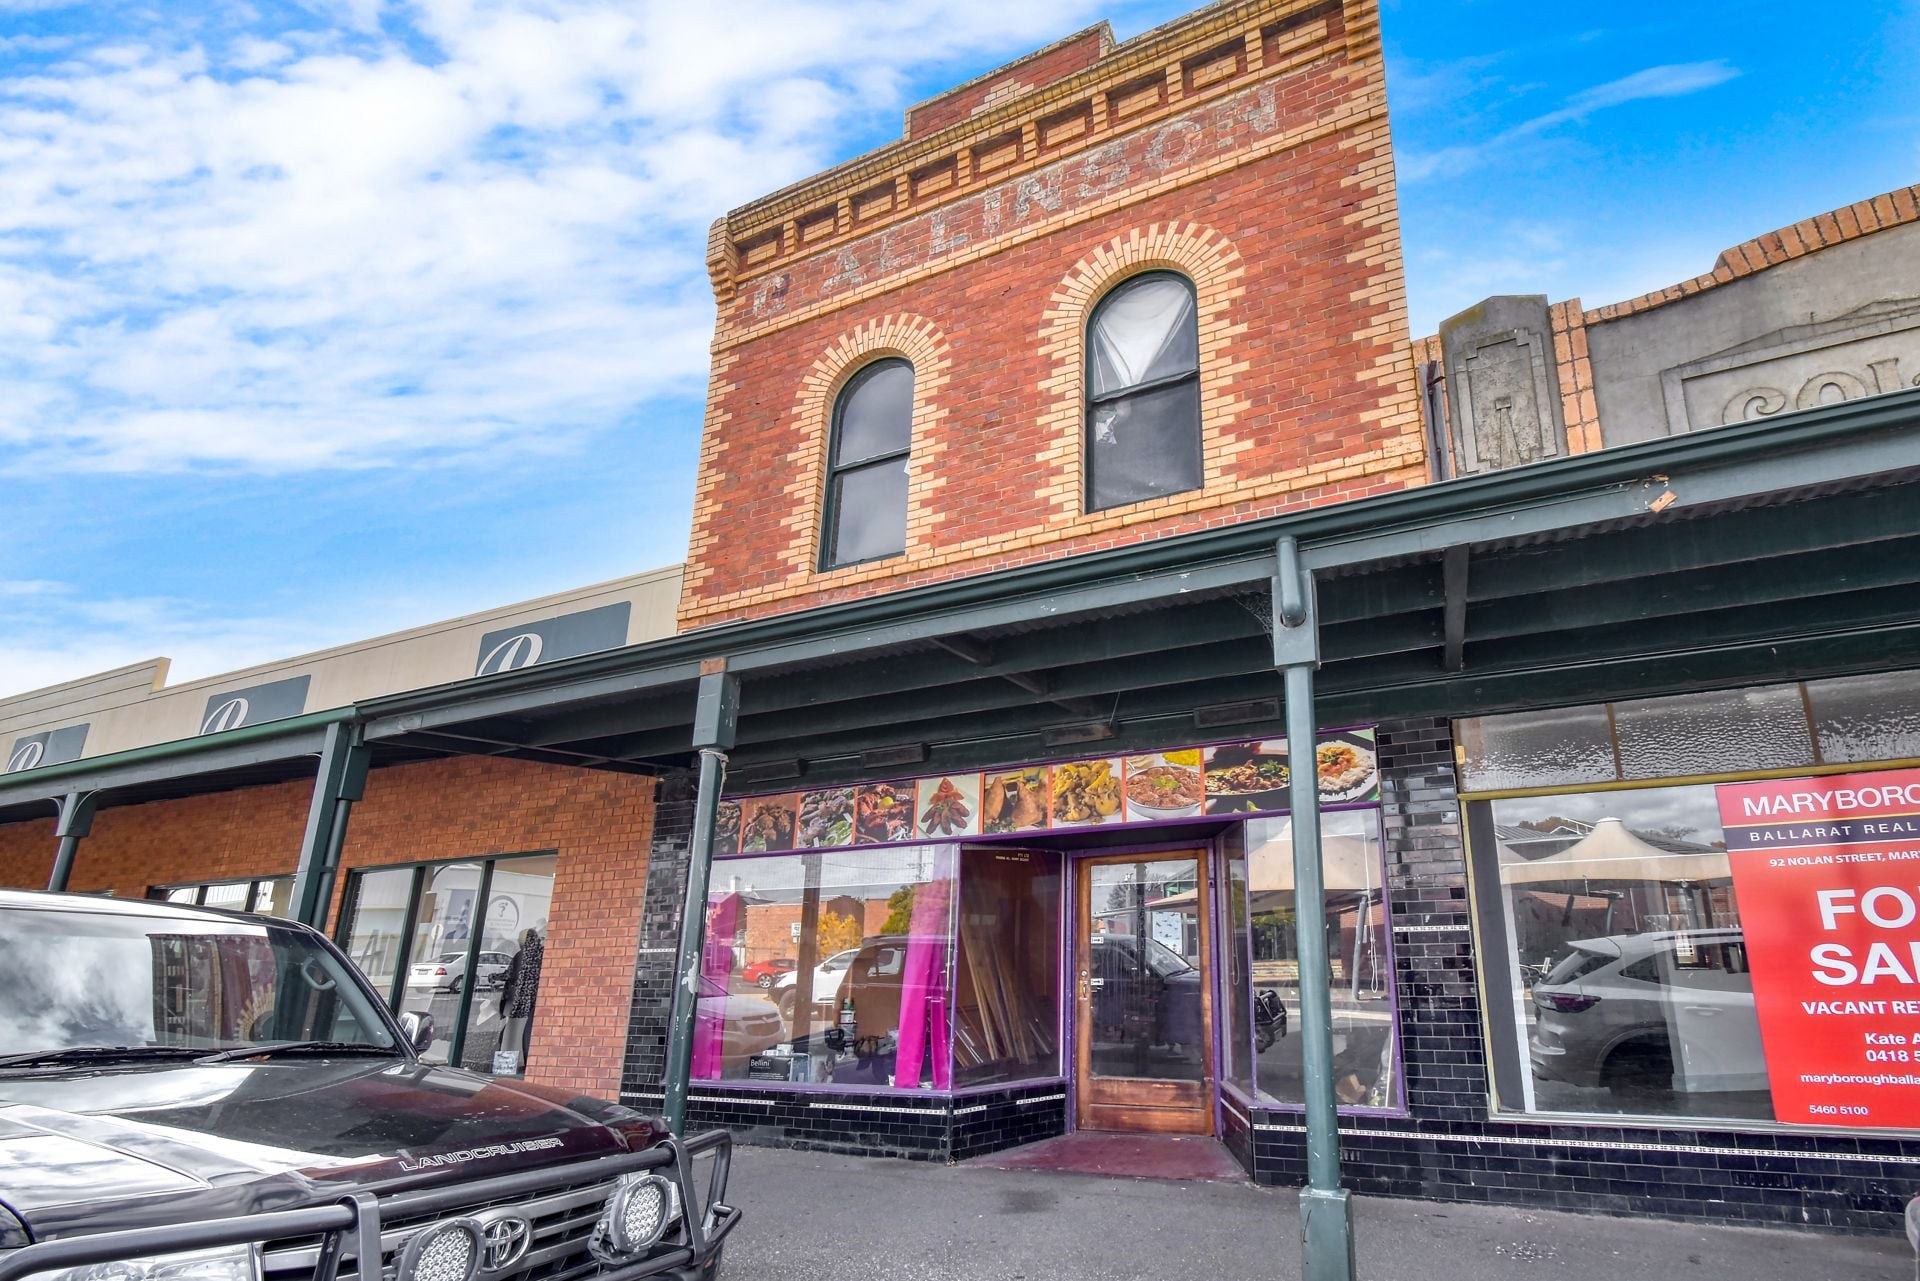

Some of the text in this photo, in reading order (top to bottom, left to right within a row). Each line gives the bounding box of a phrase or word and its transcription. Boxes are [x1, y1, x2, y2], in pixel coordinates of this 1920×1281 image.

[1750, 821, 1918, 842] BALLARAT REAL
[1769, 858, 1786, 867] 92
[1788, 855, 1833, 866] NOLAN
[1836, 852, 1886, 863] STREET,
[1816, 885, 1920, 930] FO
[1801, 1000, 1920, 1015] VACANT RE
[1864, 1032, 1906, 1045] Kate
[750, 1059, 770, 1067] Bellini
[1866, 1050, 1909, 1062] 0418
[1809, 1104, 1868, 1115] 5460 5100
[399, 1137, 564, 1172] LANDCRUISER
